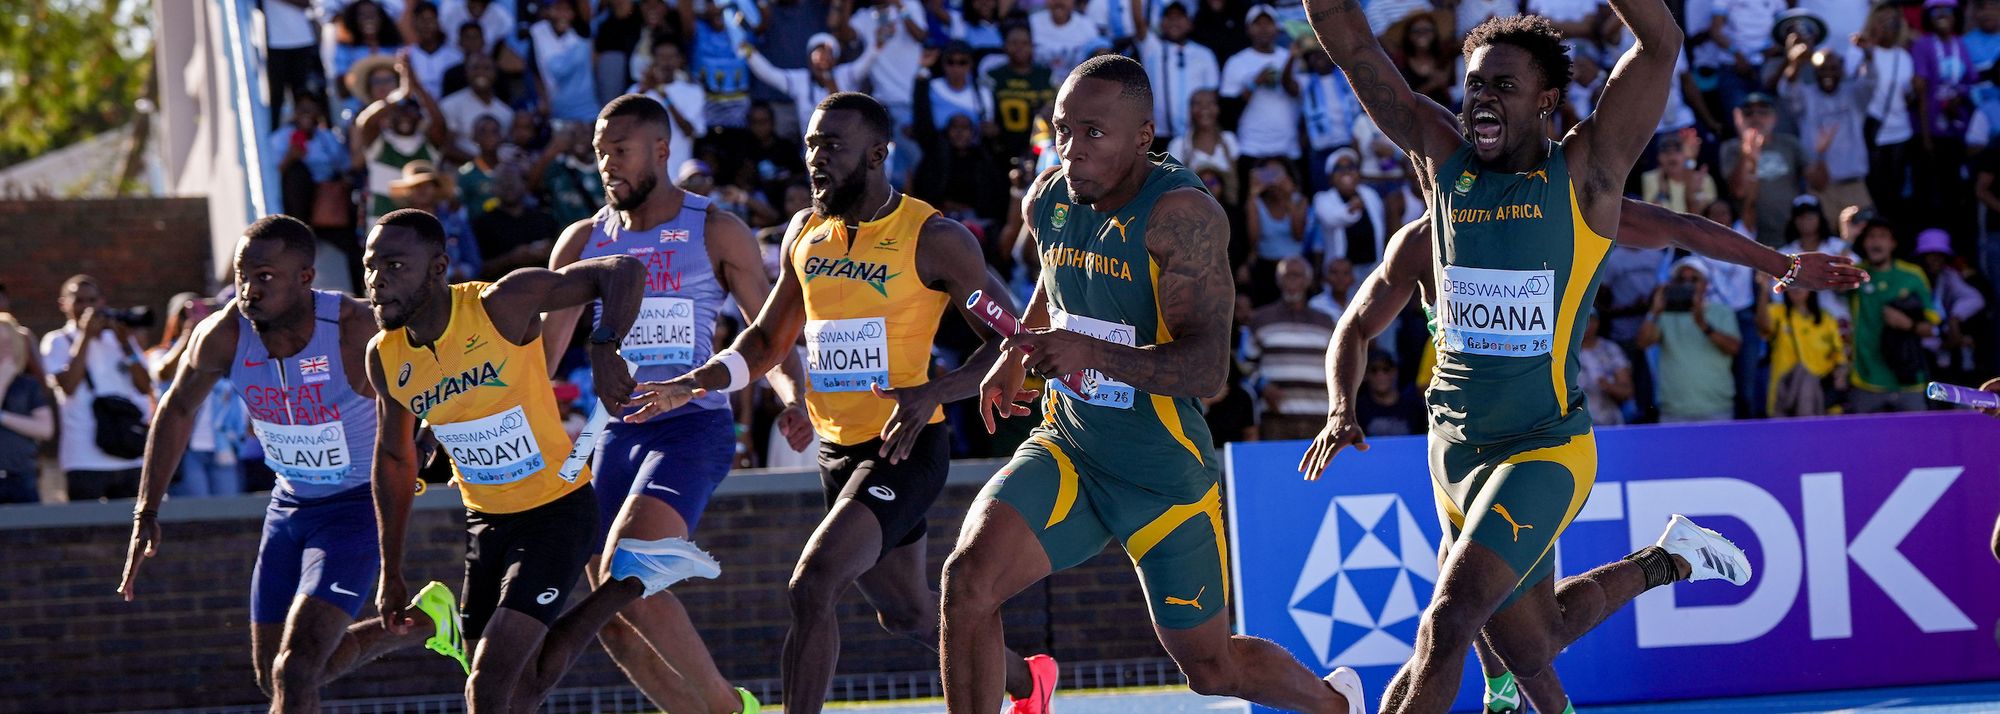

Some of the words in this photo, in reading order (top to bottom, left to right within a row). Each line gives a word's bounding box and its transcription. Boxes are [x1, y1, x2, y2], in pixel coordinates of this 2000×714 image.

[1451, 208, 1493, 223] SOUTH
[1496, 203, 1543, 221] AFRICA
[804, 256, 888, 283] GHANA
[1043, 247, 1086, 269] SOUTH
[1444, 279, 1529, 299] DEBSWANA
[1446, 299, 1547, 331] NKOANA
[1532, 338, 1548, 352] 26
[809, 347, 881, 371] AMOAH
[245, 383, 324, 407] GREAT
[409, 361, 499, 415] GHANA
[437, 425, 509, 443] DEBSWANA
[266, 442, 343, 468] GLAVE
[453, 435, 532, 467] GADAYI
[526, 457, 541, 471] 26
[1554, 466, 1978, 649] DK
